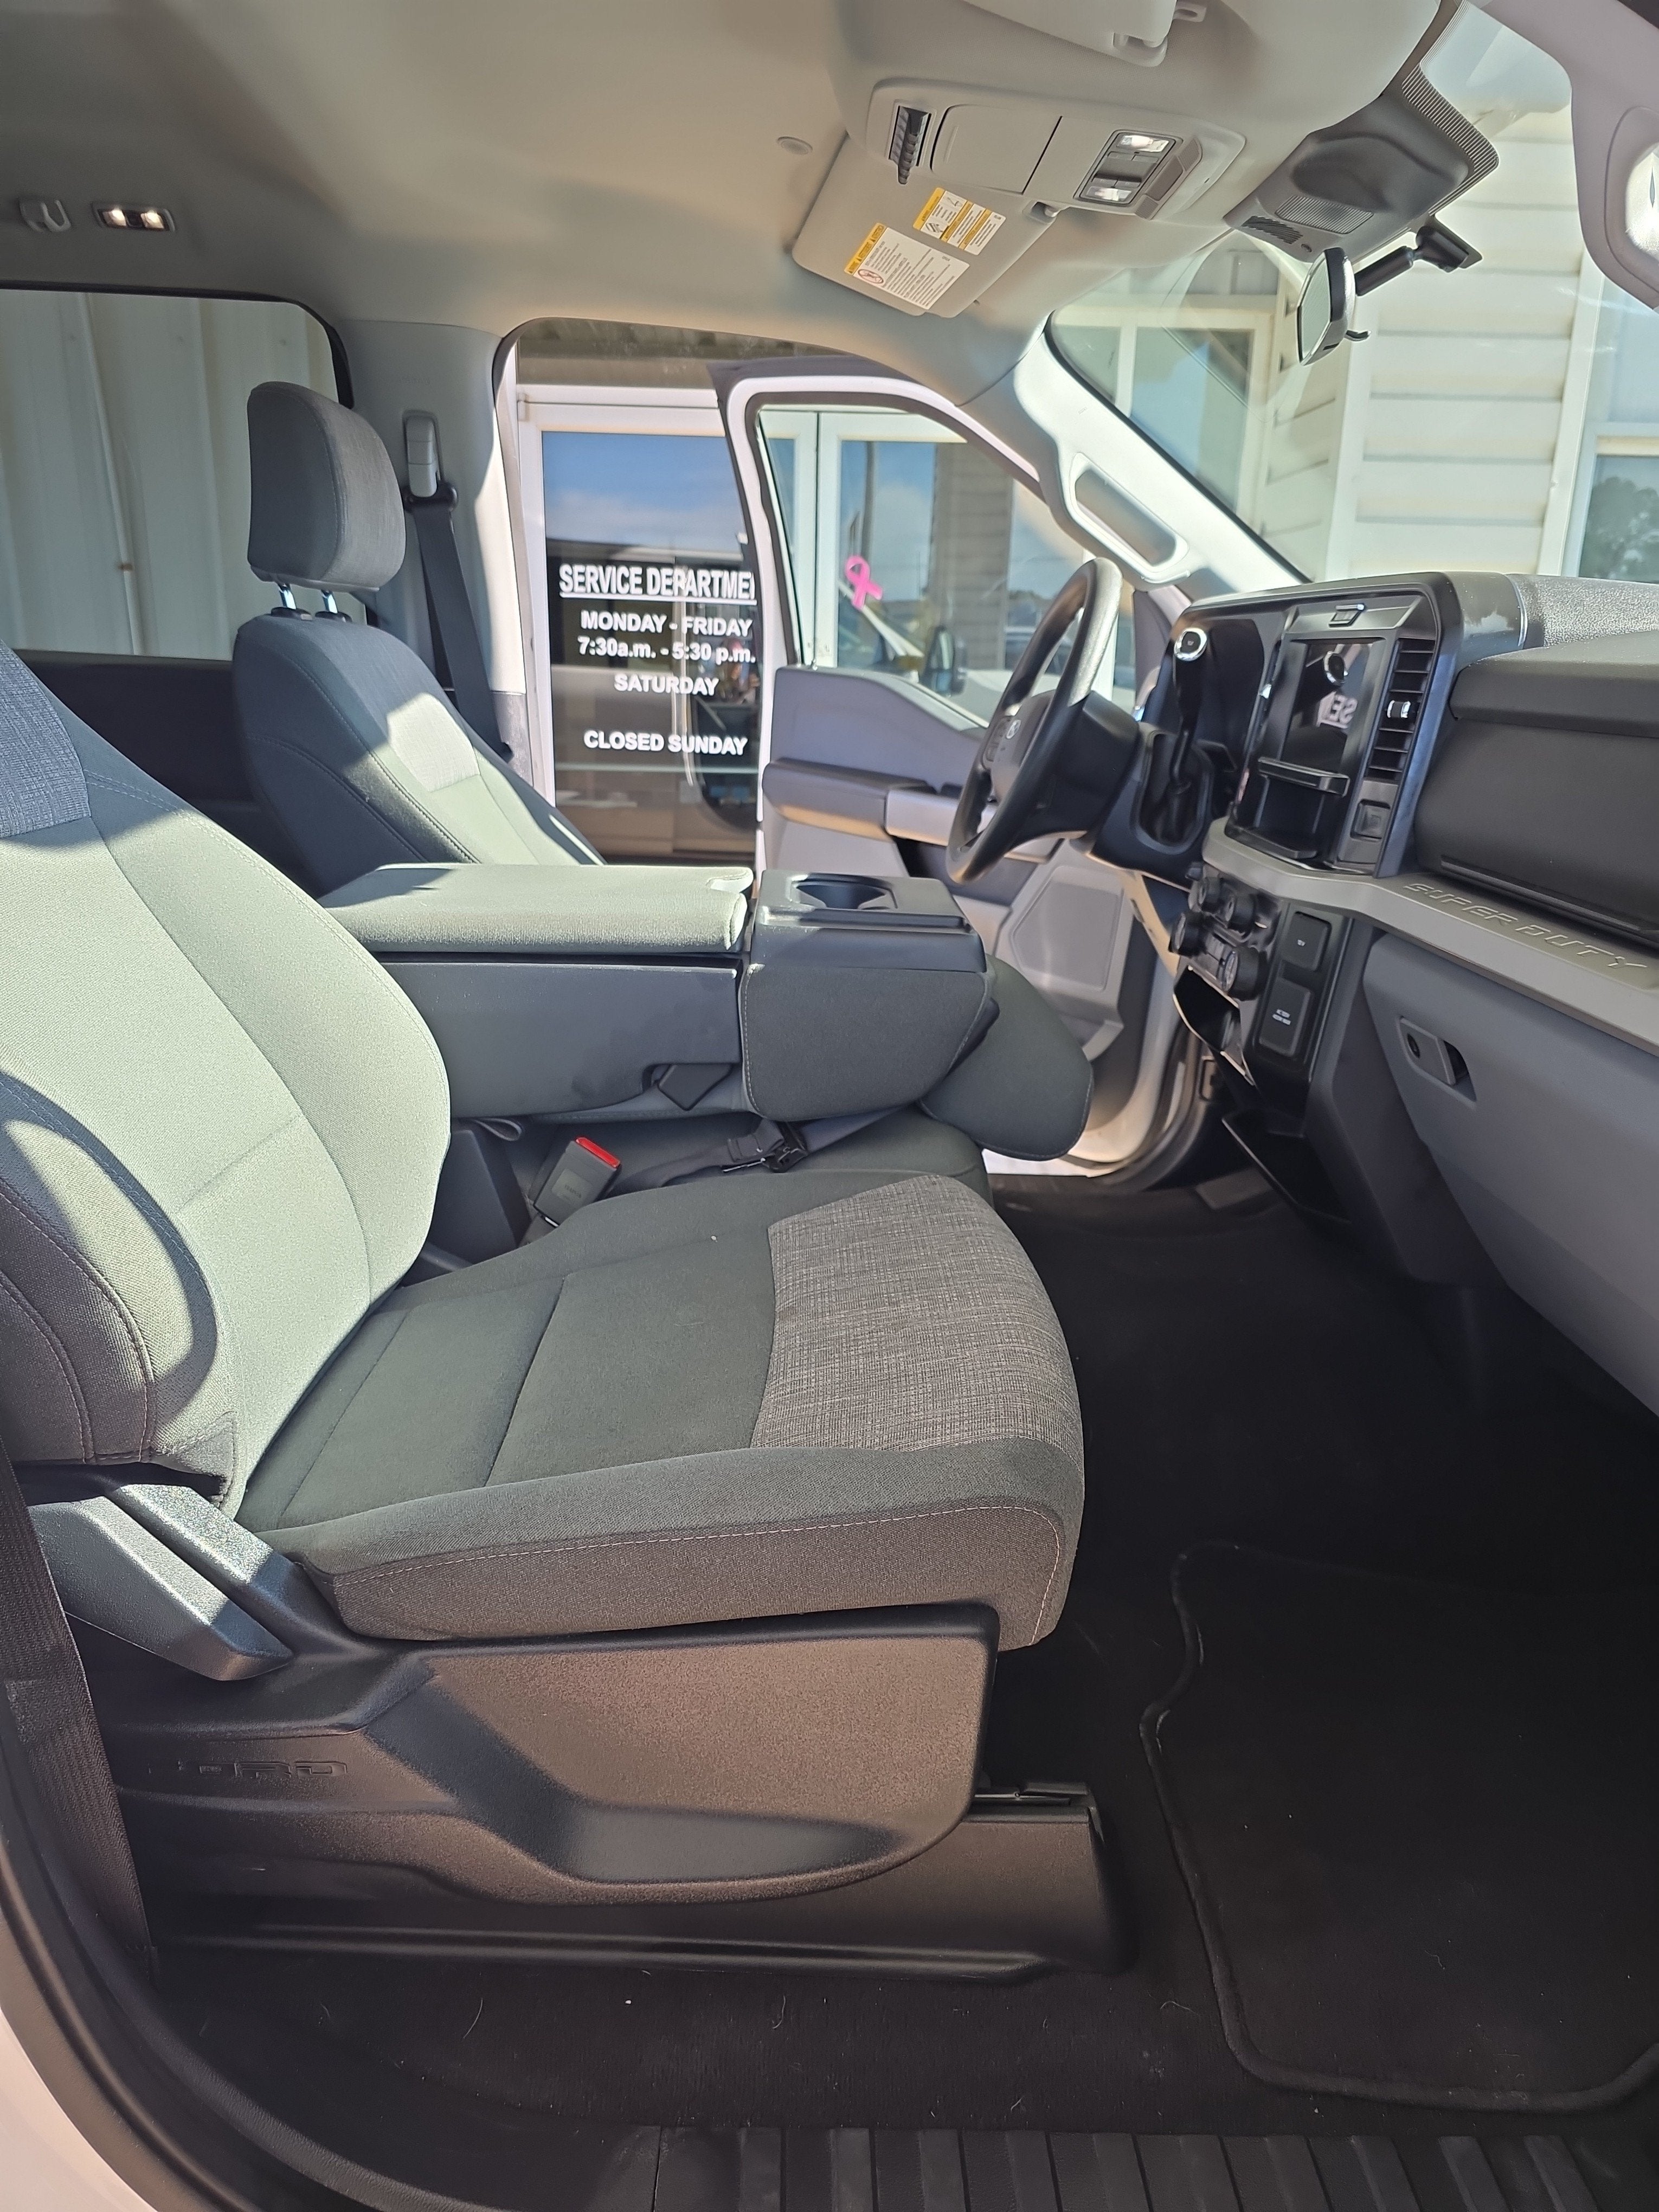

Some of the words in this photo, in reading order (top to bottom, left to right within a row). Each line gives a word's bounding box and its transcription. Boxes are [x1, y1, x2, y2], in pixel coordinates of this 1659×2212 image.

[559, 564, 642, 594] SERVICE
[581, 610, 667, 633] MONDAY
[681, 616, 753, 637] FRIDAY
[577, 636, 657, 659] 7:30a.m.
[672, 642, 712, 662] 5:30
[716, 647, 756, 665] p.m.
[614, 673, 719, 696] SATURDAY
[583, 730, 664, 751] CLOSED
[668, 734, 748, 756] SUNDAY
